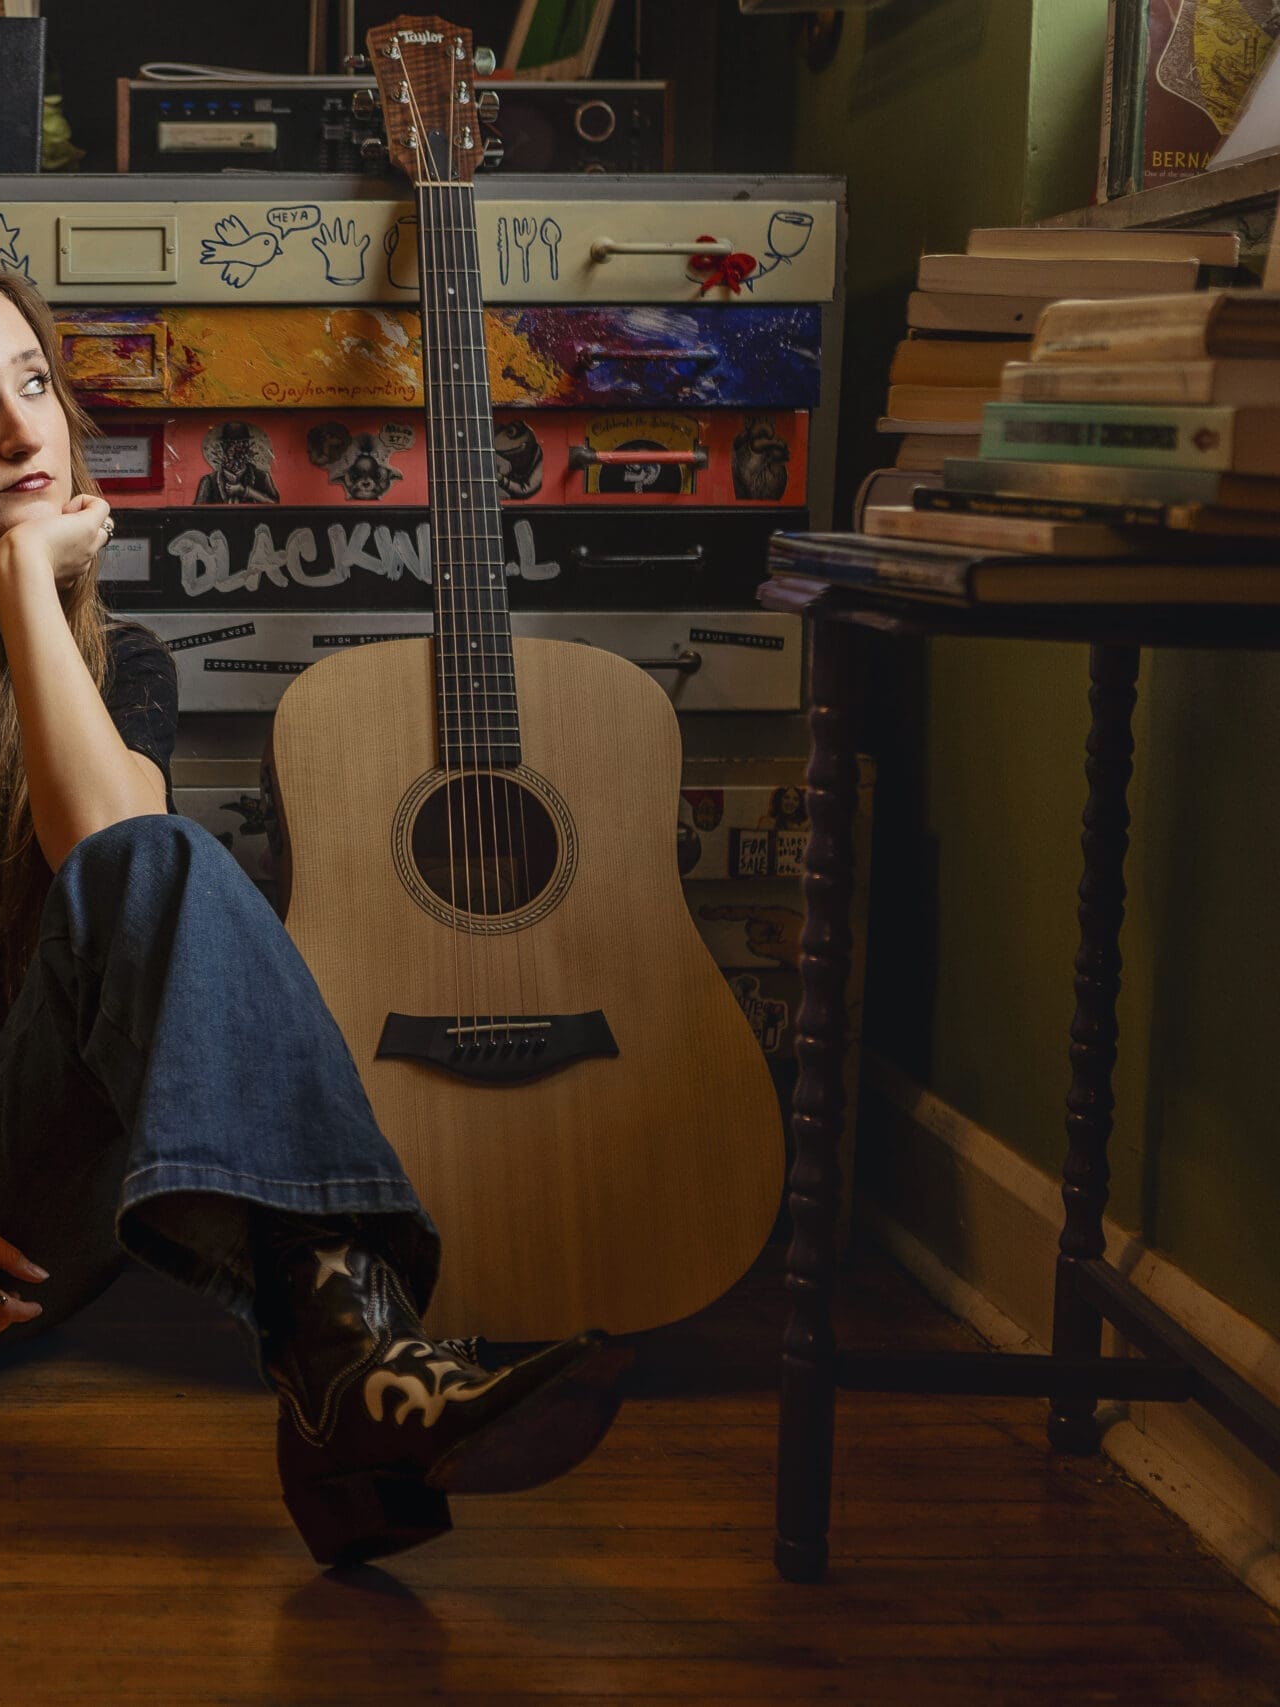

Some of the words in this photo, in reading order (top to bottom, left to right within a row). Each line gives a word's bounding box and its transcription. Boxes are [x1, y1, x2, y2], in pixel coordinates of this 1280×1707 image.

[397, 29, 445, 46] Taylor
[1151, 150, 1212, 169] BERNA
[205, 661, 270, 672] CORPORATE
[742, 839, 768, 855] FOR
